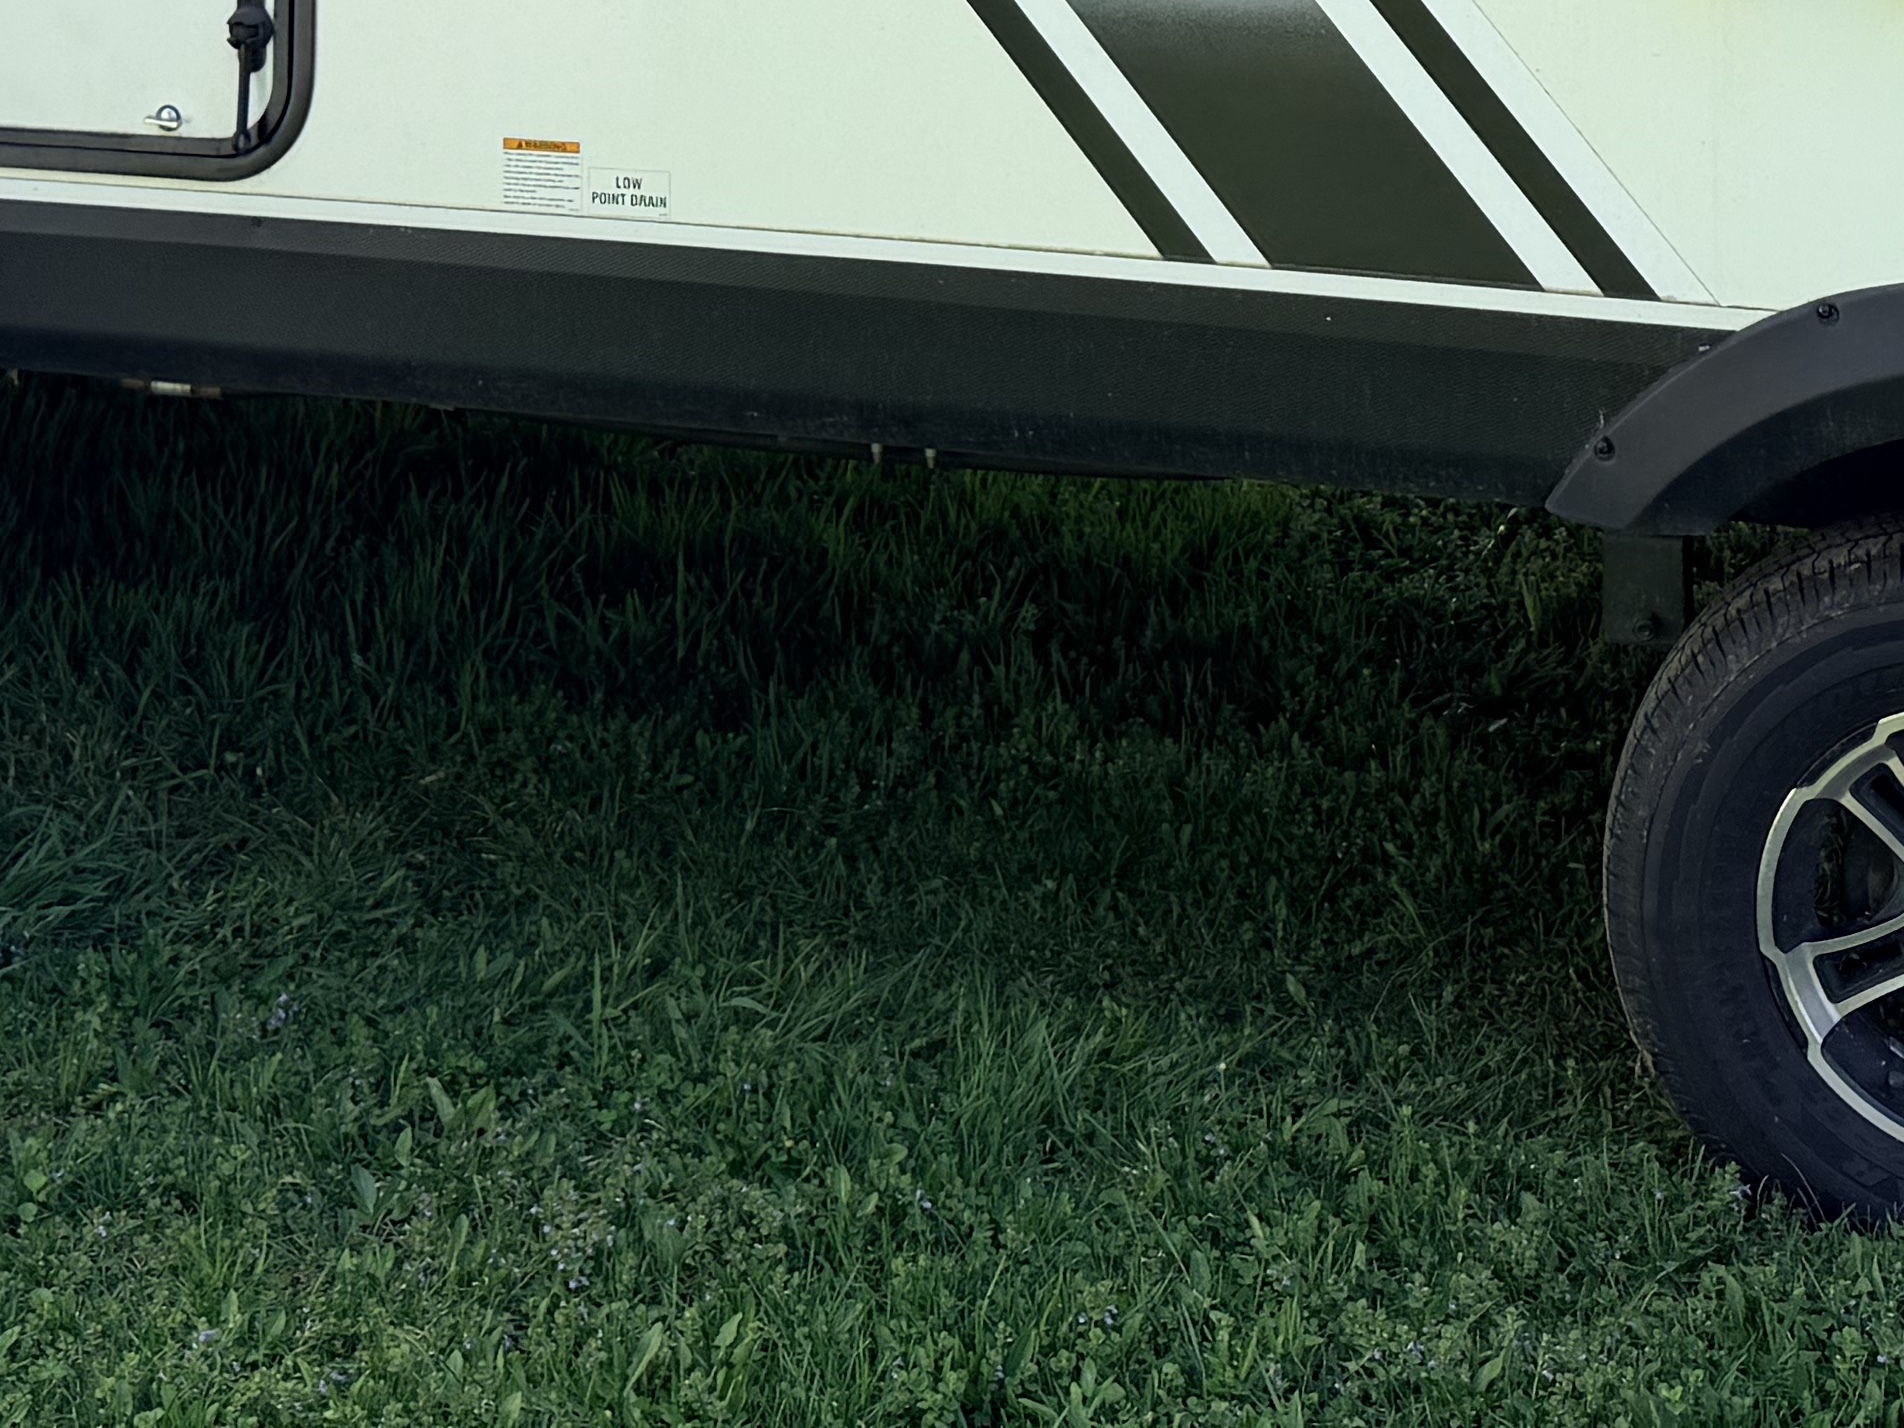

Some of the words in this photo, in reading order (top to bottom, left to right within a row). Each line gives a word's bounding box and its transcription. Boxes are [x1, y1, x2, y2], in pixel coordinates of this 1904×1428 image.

[615, 175, 643, 191] LOW
[591, 191, 626, 206] POINT
[629, 193, 667, 208] DRAIN
